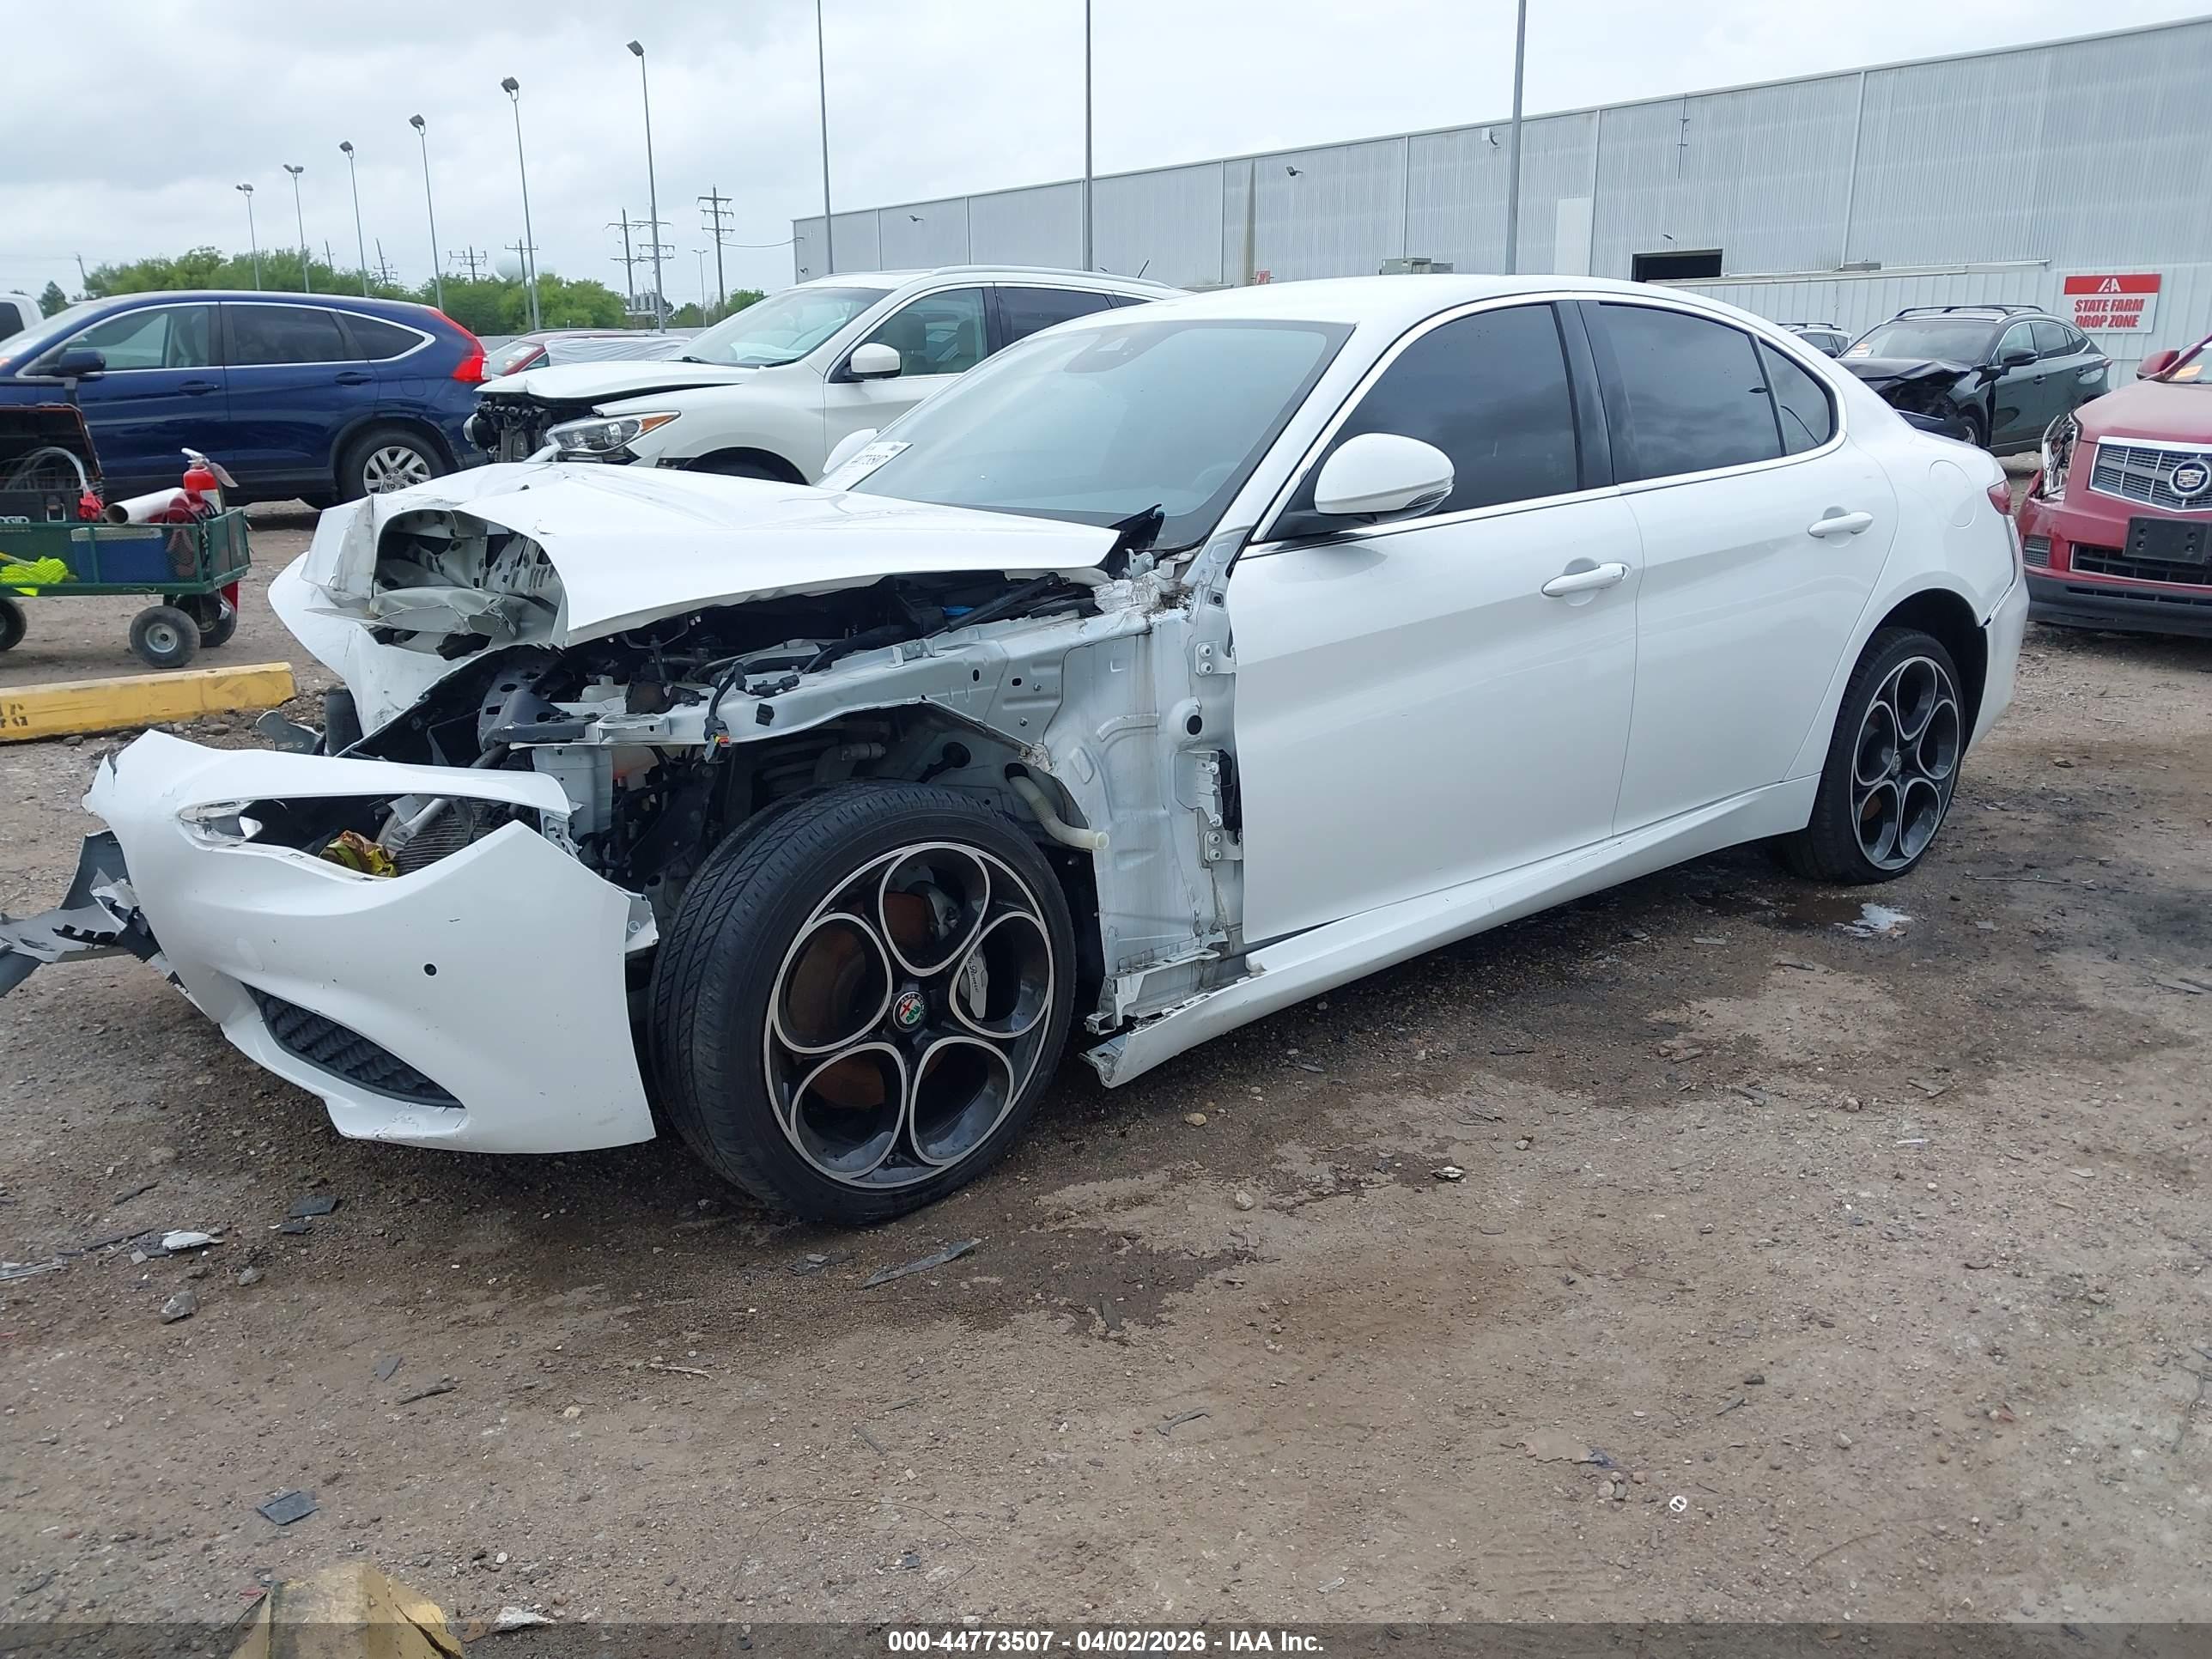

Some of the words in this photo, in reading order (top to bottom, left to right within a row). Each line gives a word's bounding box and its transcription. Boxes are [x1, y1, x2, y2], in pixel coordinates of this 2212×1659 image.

[2074, 299, 2110, 313] STATE
[2110, 298, 2145, 312] FARM
[2075, 314, 2108, 328] DROP
[2108, 314, 2140, 328] ZONE
